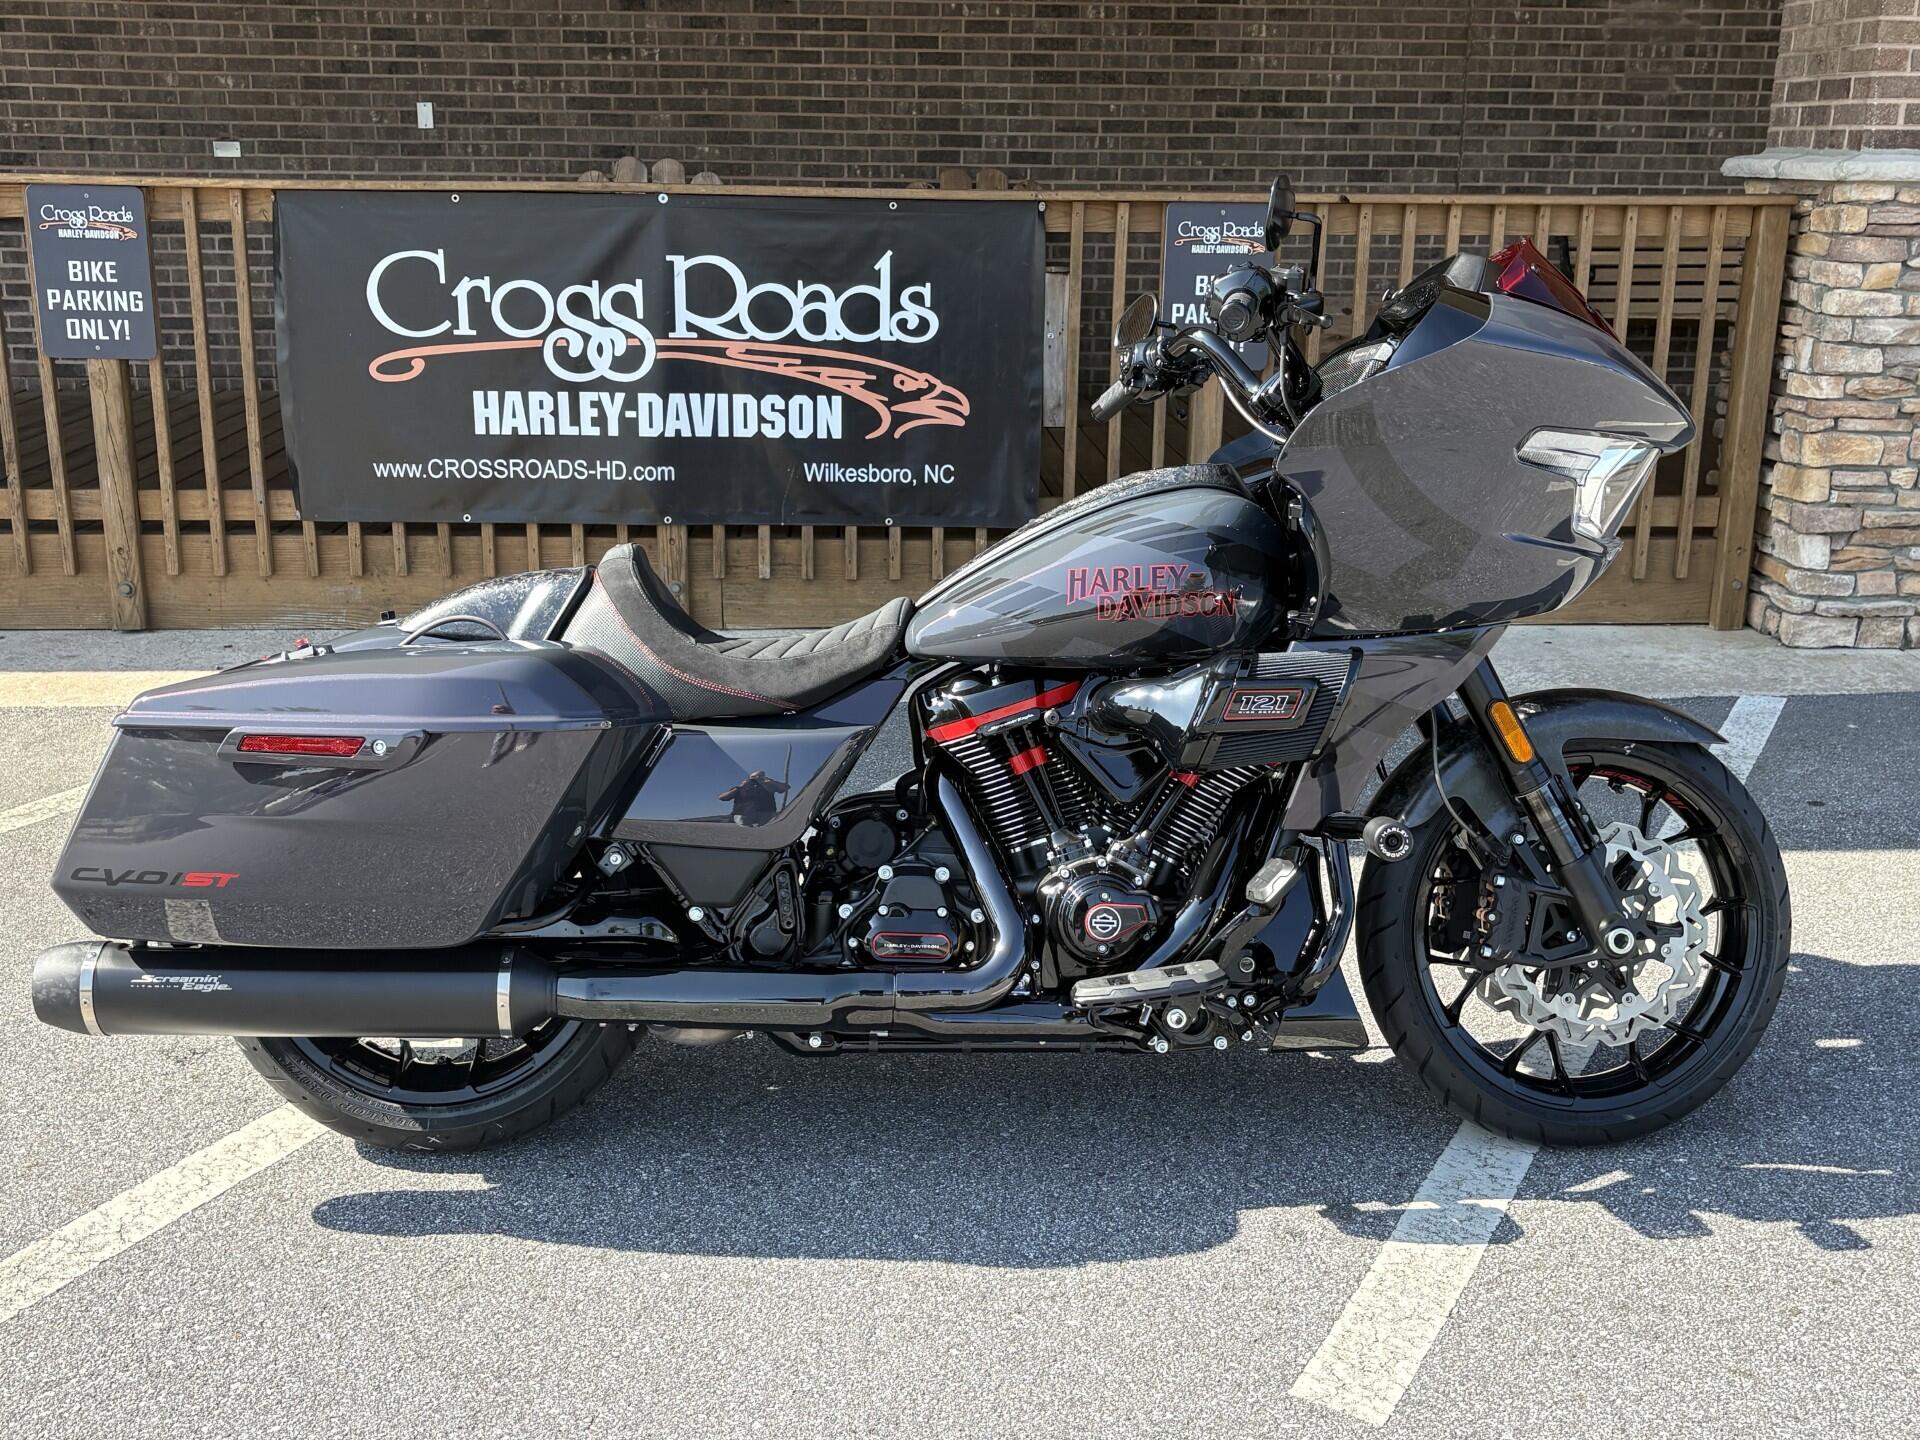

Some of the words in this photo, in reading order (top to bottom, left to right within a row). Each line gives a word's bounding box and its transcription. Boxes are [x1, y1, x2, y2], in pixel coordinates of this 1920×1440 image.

[40, 204, 88, 229] Cross
[88, 205, 134, 223] Roads
[58, 228, 120, 240] HARLEY-DAVIDSON
[1177, 220, 1220, 244] Cross
[1223, 220, 1265, 238] Roads
[1191, 244, 1249, 255] HARLEY-DAVIDSON
[67, 260, 118, 283] BIKE
[46, 288, 144, 313] PARKING
[366, 248, 657, 383] Cross
[665, 249, 939, 344] Roads
[66, 318, 131, 341] ONLY!
[472, 390, 843, 440] HARLEY-DAVIDSON
[372, 458, 675, 482] www.CROSSROADS-HD.com
[803, 462, 917, 486] Wilkesboro,
[924, 464, 956, 485] NC
[1097, 592, 1236, 621] DAVIDSON
[1240, 695, 1289, 711] 121
[181, 981, 233, 993] Eagle
